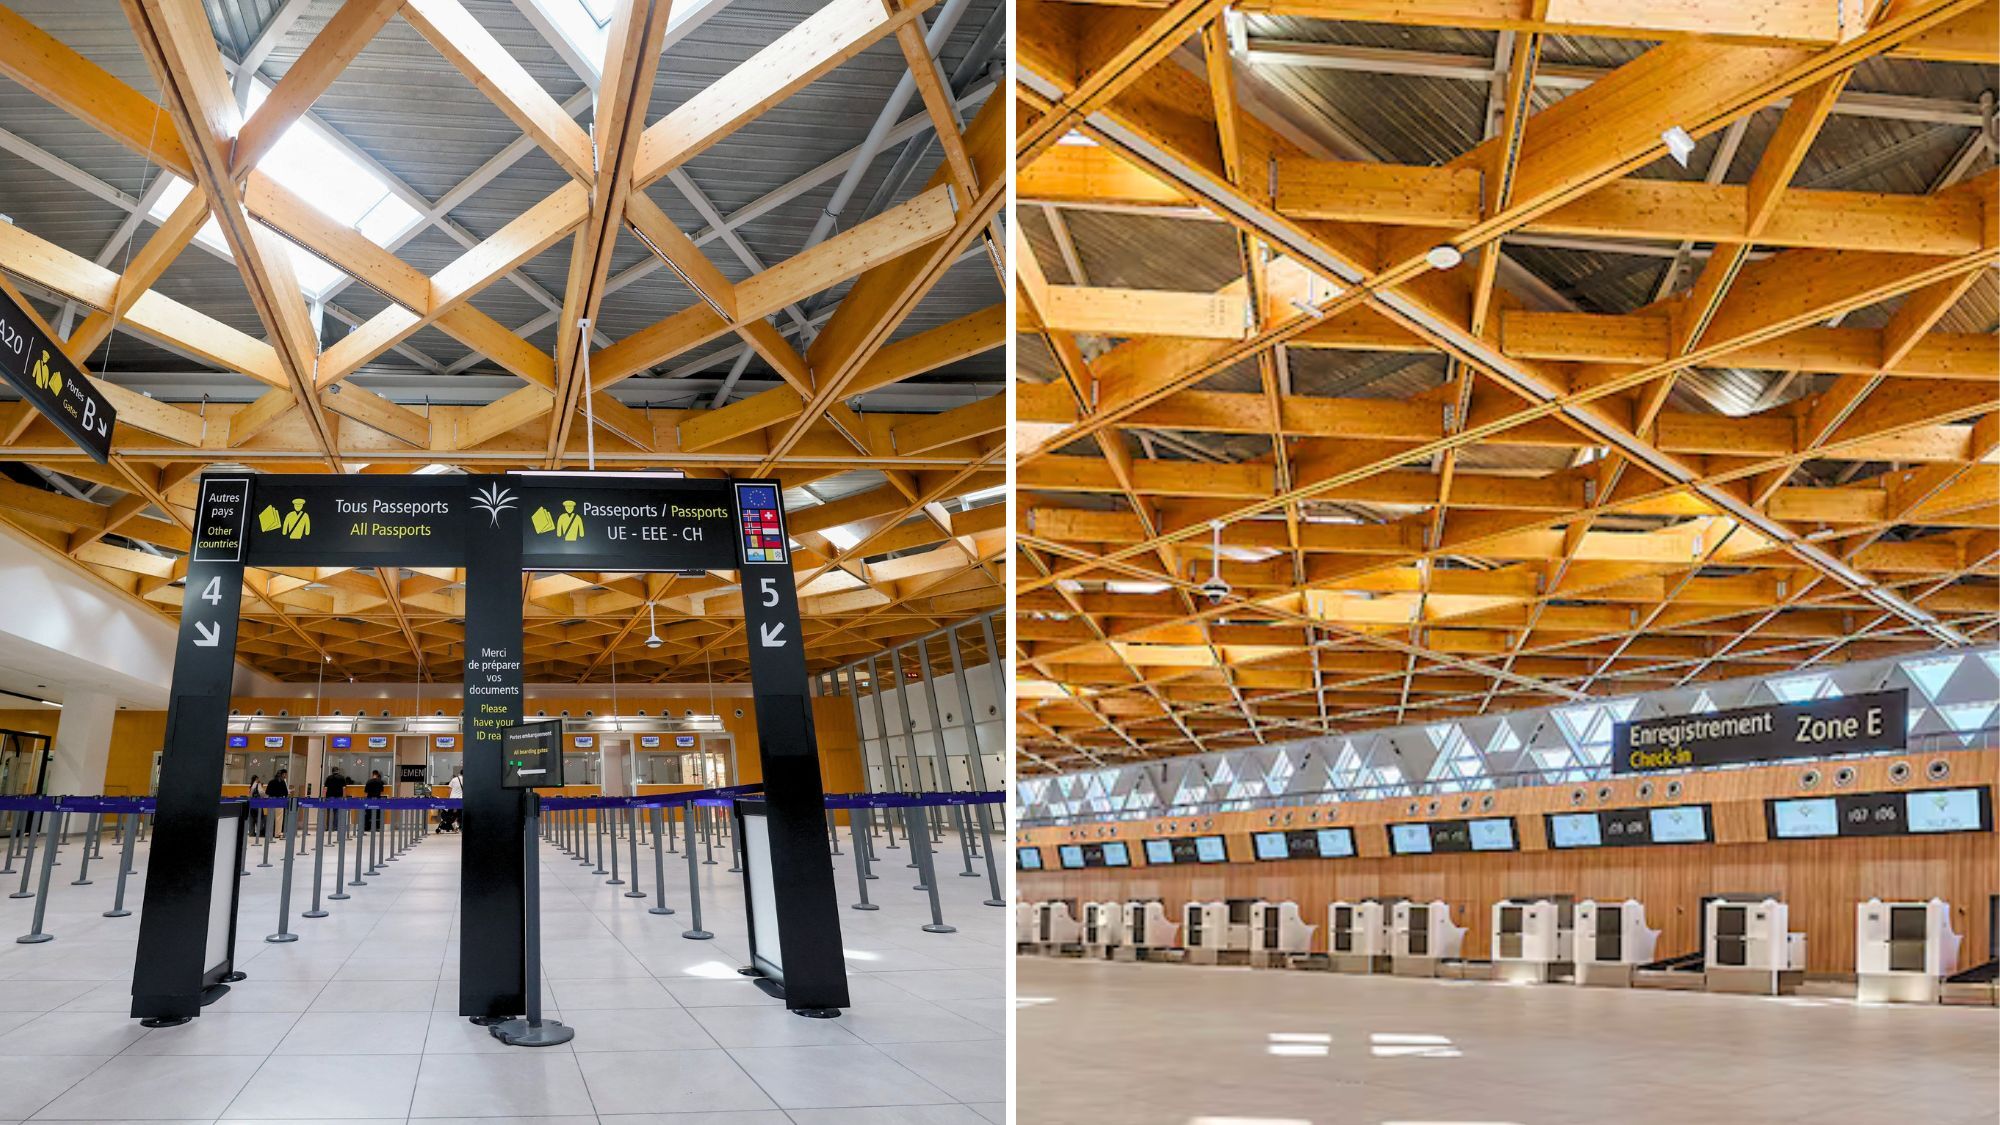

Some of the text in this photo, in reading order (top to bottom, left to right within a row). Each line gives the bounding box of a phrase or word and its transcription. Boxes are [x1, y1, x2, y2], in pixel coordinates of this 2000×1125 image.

[0, 318, 23, 355] A20
[66, 378, 85, 402] Portes
[62, 399, 78, 419] Gates
[82, 396, 96, 431] B
[208, 493, 240, 503] Autres
[211, 507, 234, 518] pays
[336, 499, 449, 517] Tous Passeports
[583, 502, 658, 520] Passeports
[671, 505, 728, 520] Passports
[207, 526, 232, 536] Other
[350, 522, 432, 539] All Passports
[607, 526, 628, 540] UE
[642, 526, 668, 541] EEE
[682, 527, 703, 542] CH
[198, 538, 239, 549] countries
[201, 576, 222, 606] 4
[760, 578, 780, 608] 5
[481, 648, 507, 658] Merci
[468, 660, 520, 672] de préparer
[486, 674, 502, 682] vos
[469, 684, 519, 695] documents
[480, 704, 508, 714] Please
[473, 717, 514, 728] have your
[1630, 708, 1882, 747] Enregistrement Zone E
[476, 730, 486, 740] ID
[1630, 748, 1692, 768] Check-in
